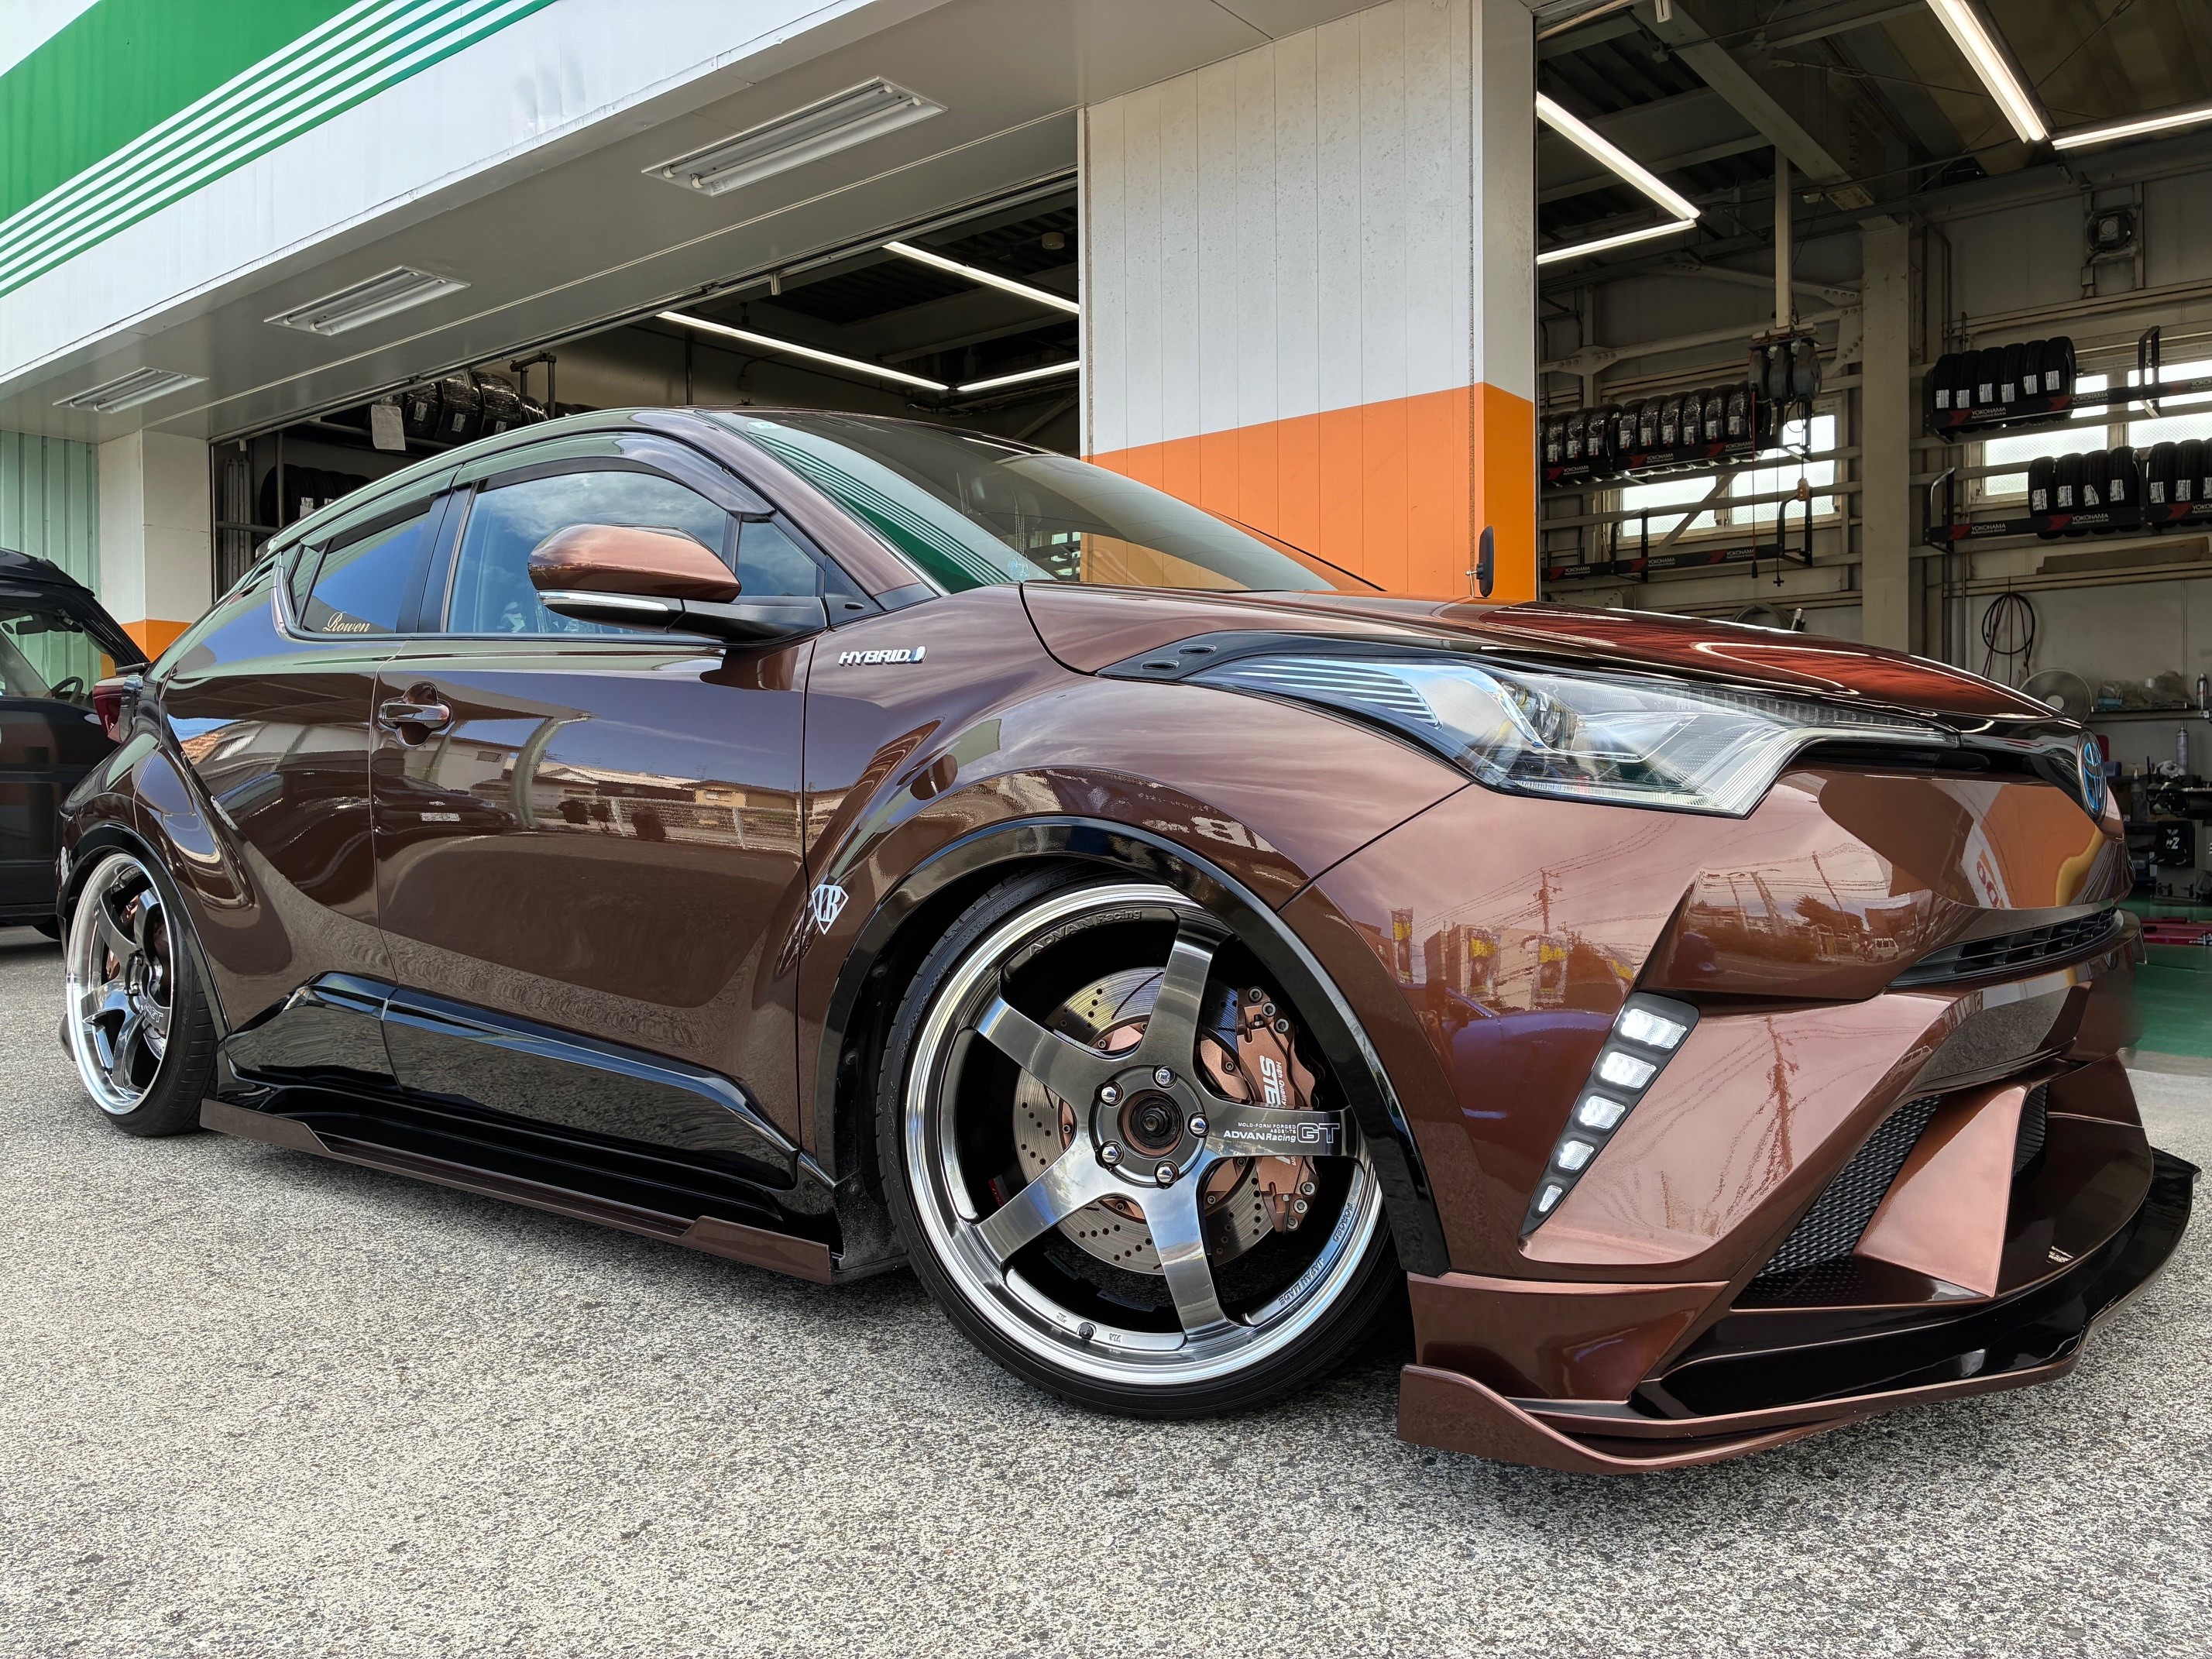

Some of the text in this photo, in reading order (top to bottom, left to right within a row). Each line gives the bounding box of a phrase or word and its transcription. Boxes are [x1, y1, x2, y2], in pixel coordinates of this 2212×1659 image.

[2072, 392, 2108, 402] YOKOHAMA
[1971, 407, 2006, 416] YOKOHAMA
[1647, 452, 1674, 461] YOKOHAMA
[2072, 513, 2108, 522] YOKOHAMA
[1971, 523, 2006, 533] YOKOHAMA
[1647, 557, 1675, 565] YOKOHAMA
[1565, 565, 1590, 574] YOKOHAMA
[322, 611, 370, 632] Rowen
[1029, 910, 1142, 957] ADVAN Racing
[1275, 1060, 1283, 1078] High
[1223, 1122, 1340, 1144] ADVAN Racing GT
[1334, 1202, 1355, 1242] FORGED
